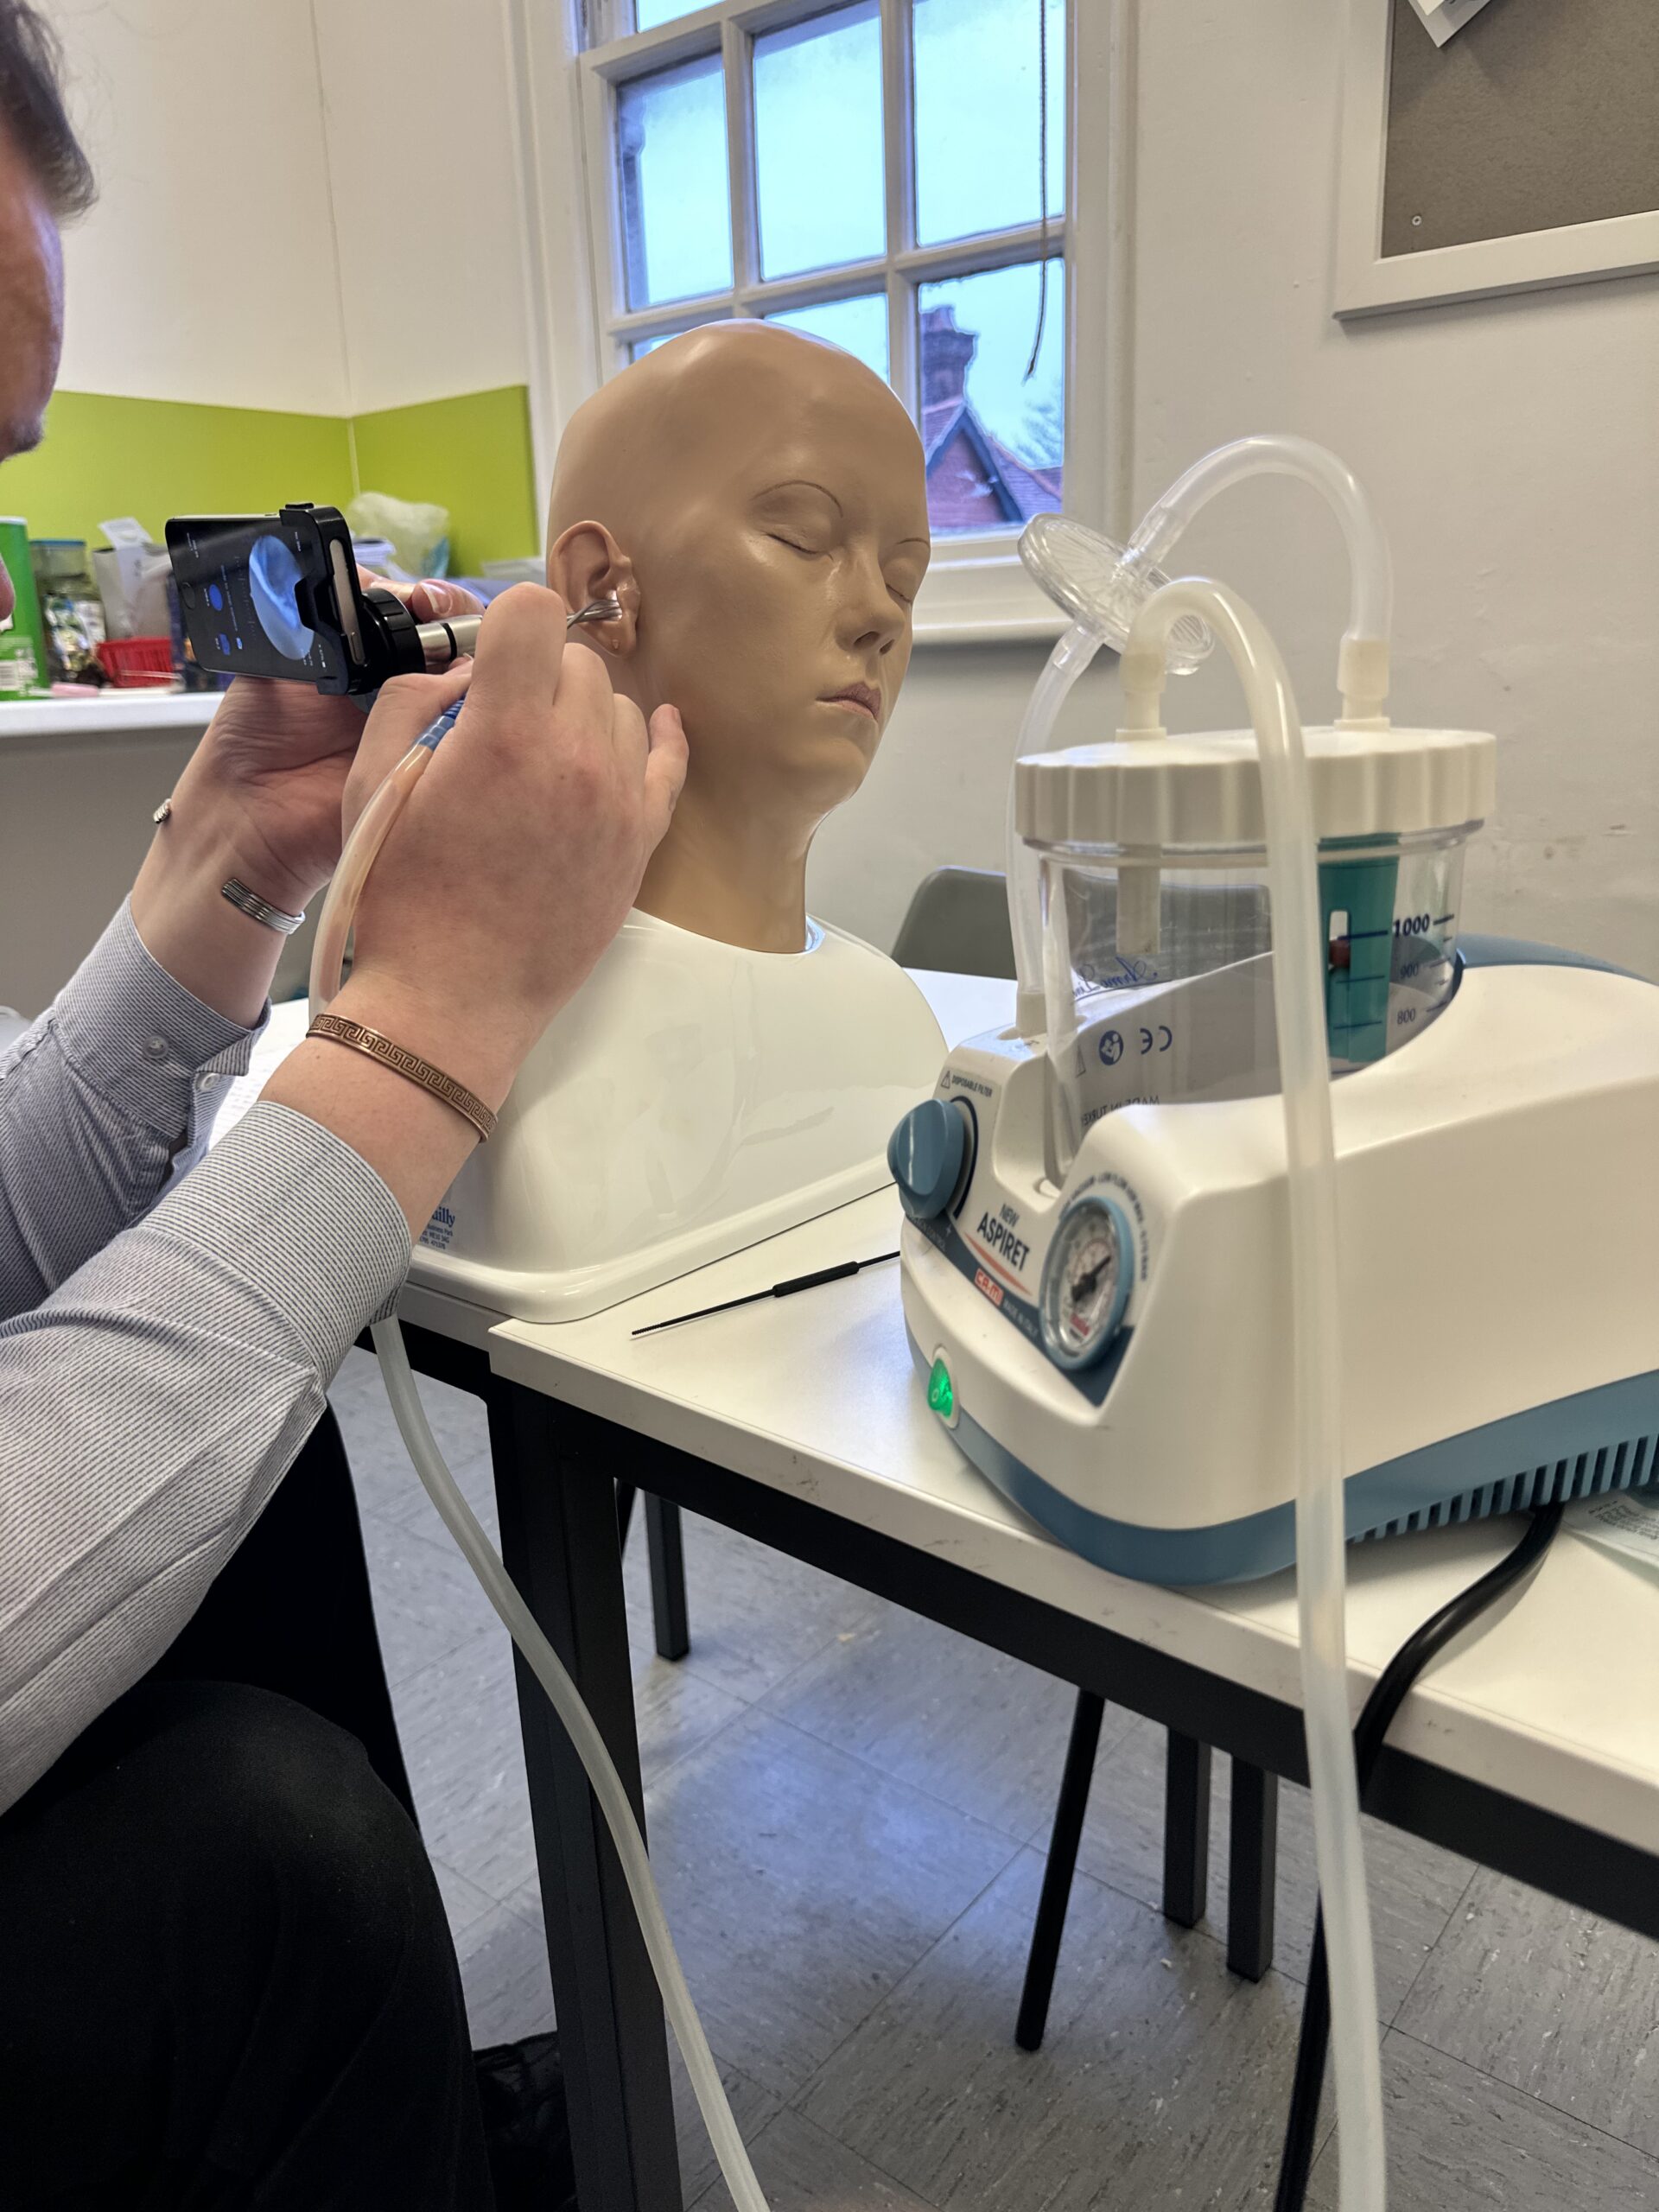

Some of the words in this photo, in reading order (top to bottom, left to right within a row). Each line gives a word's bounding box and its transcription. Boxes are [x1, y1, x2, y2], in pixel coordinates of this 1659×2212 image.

[1394, 913, 1431, 938] 1000
[1399, 963, 1419, 979] 900
[1396, 1008, 1416, 1025] 800
[976, 1082, 993, 1098] FILTER
[999, 1204, 1020, 1228] NEW
[976, 1211, 1031, 1272] ASPIRET
